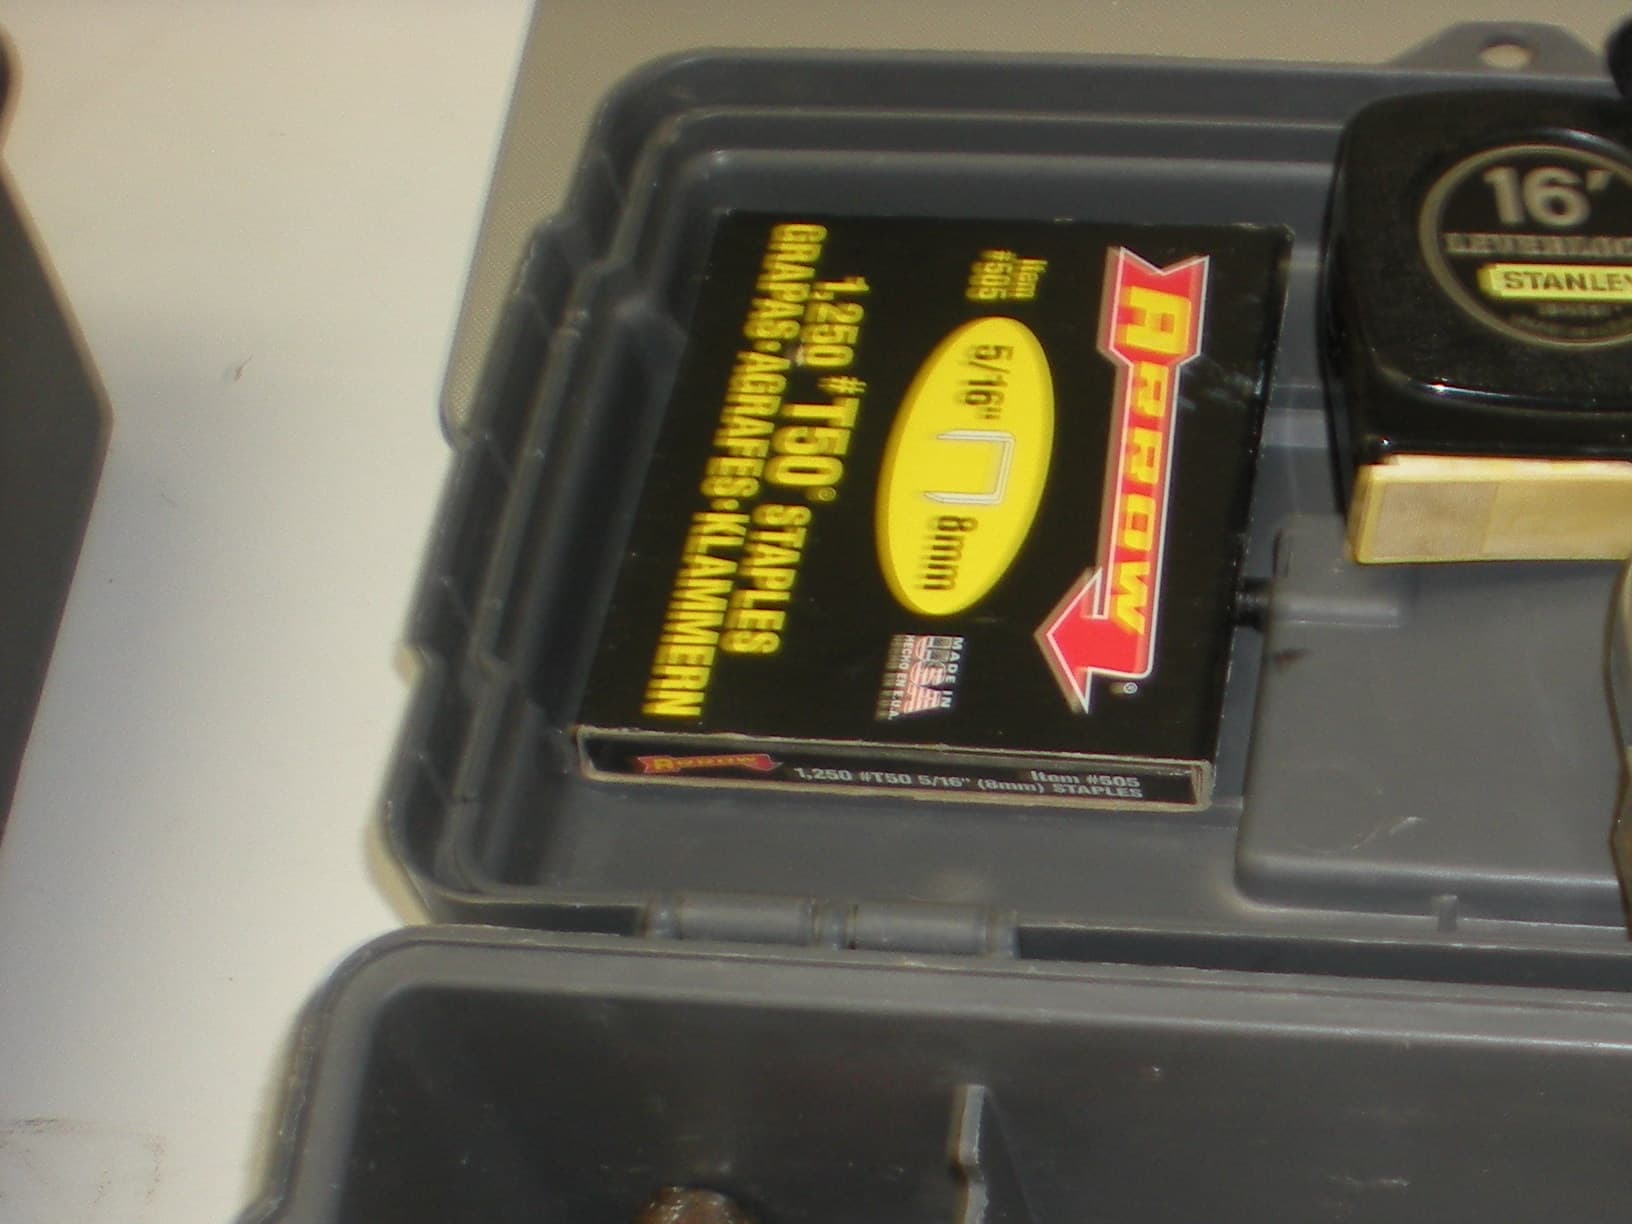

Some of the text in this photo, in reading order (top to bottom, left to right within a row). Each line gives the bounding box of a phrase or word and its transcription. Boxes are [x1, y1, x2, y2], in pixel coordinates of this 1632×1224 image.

[800, 275, 871, 368] 1,250
[1113, 285, 1193, 636] ARROW
[717, 503, 813, 654] STAPLES
[921, 514, 979, 591] 8mm
[898, 635, 917, 671] HECHO
[940, 636, 966, 709] MADE IN
[793, 766, 1144, 799] 1,250 #T50 5/16" (8mm) STAPLES
[1030, 769, 1142, 789] Item #505
